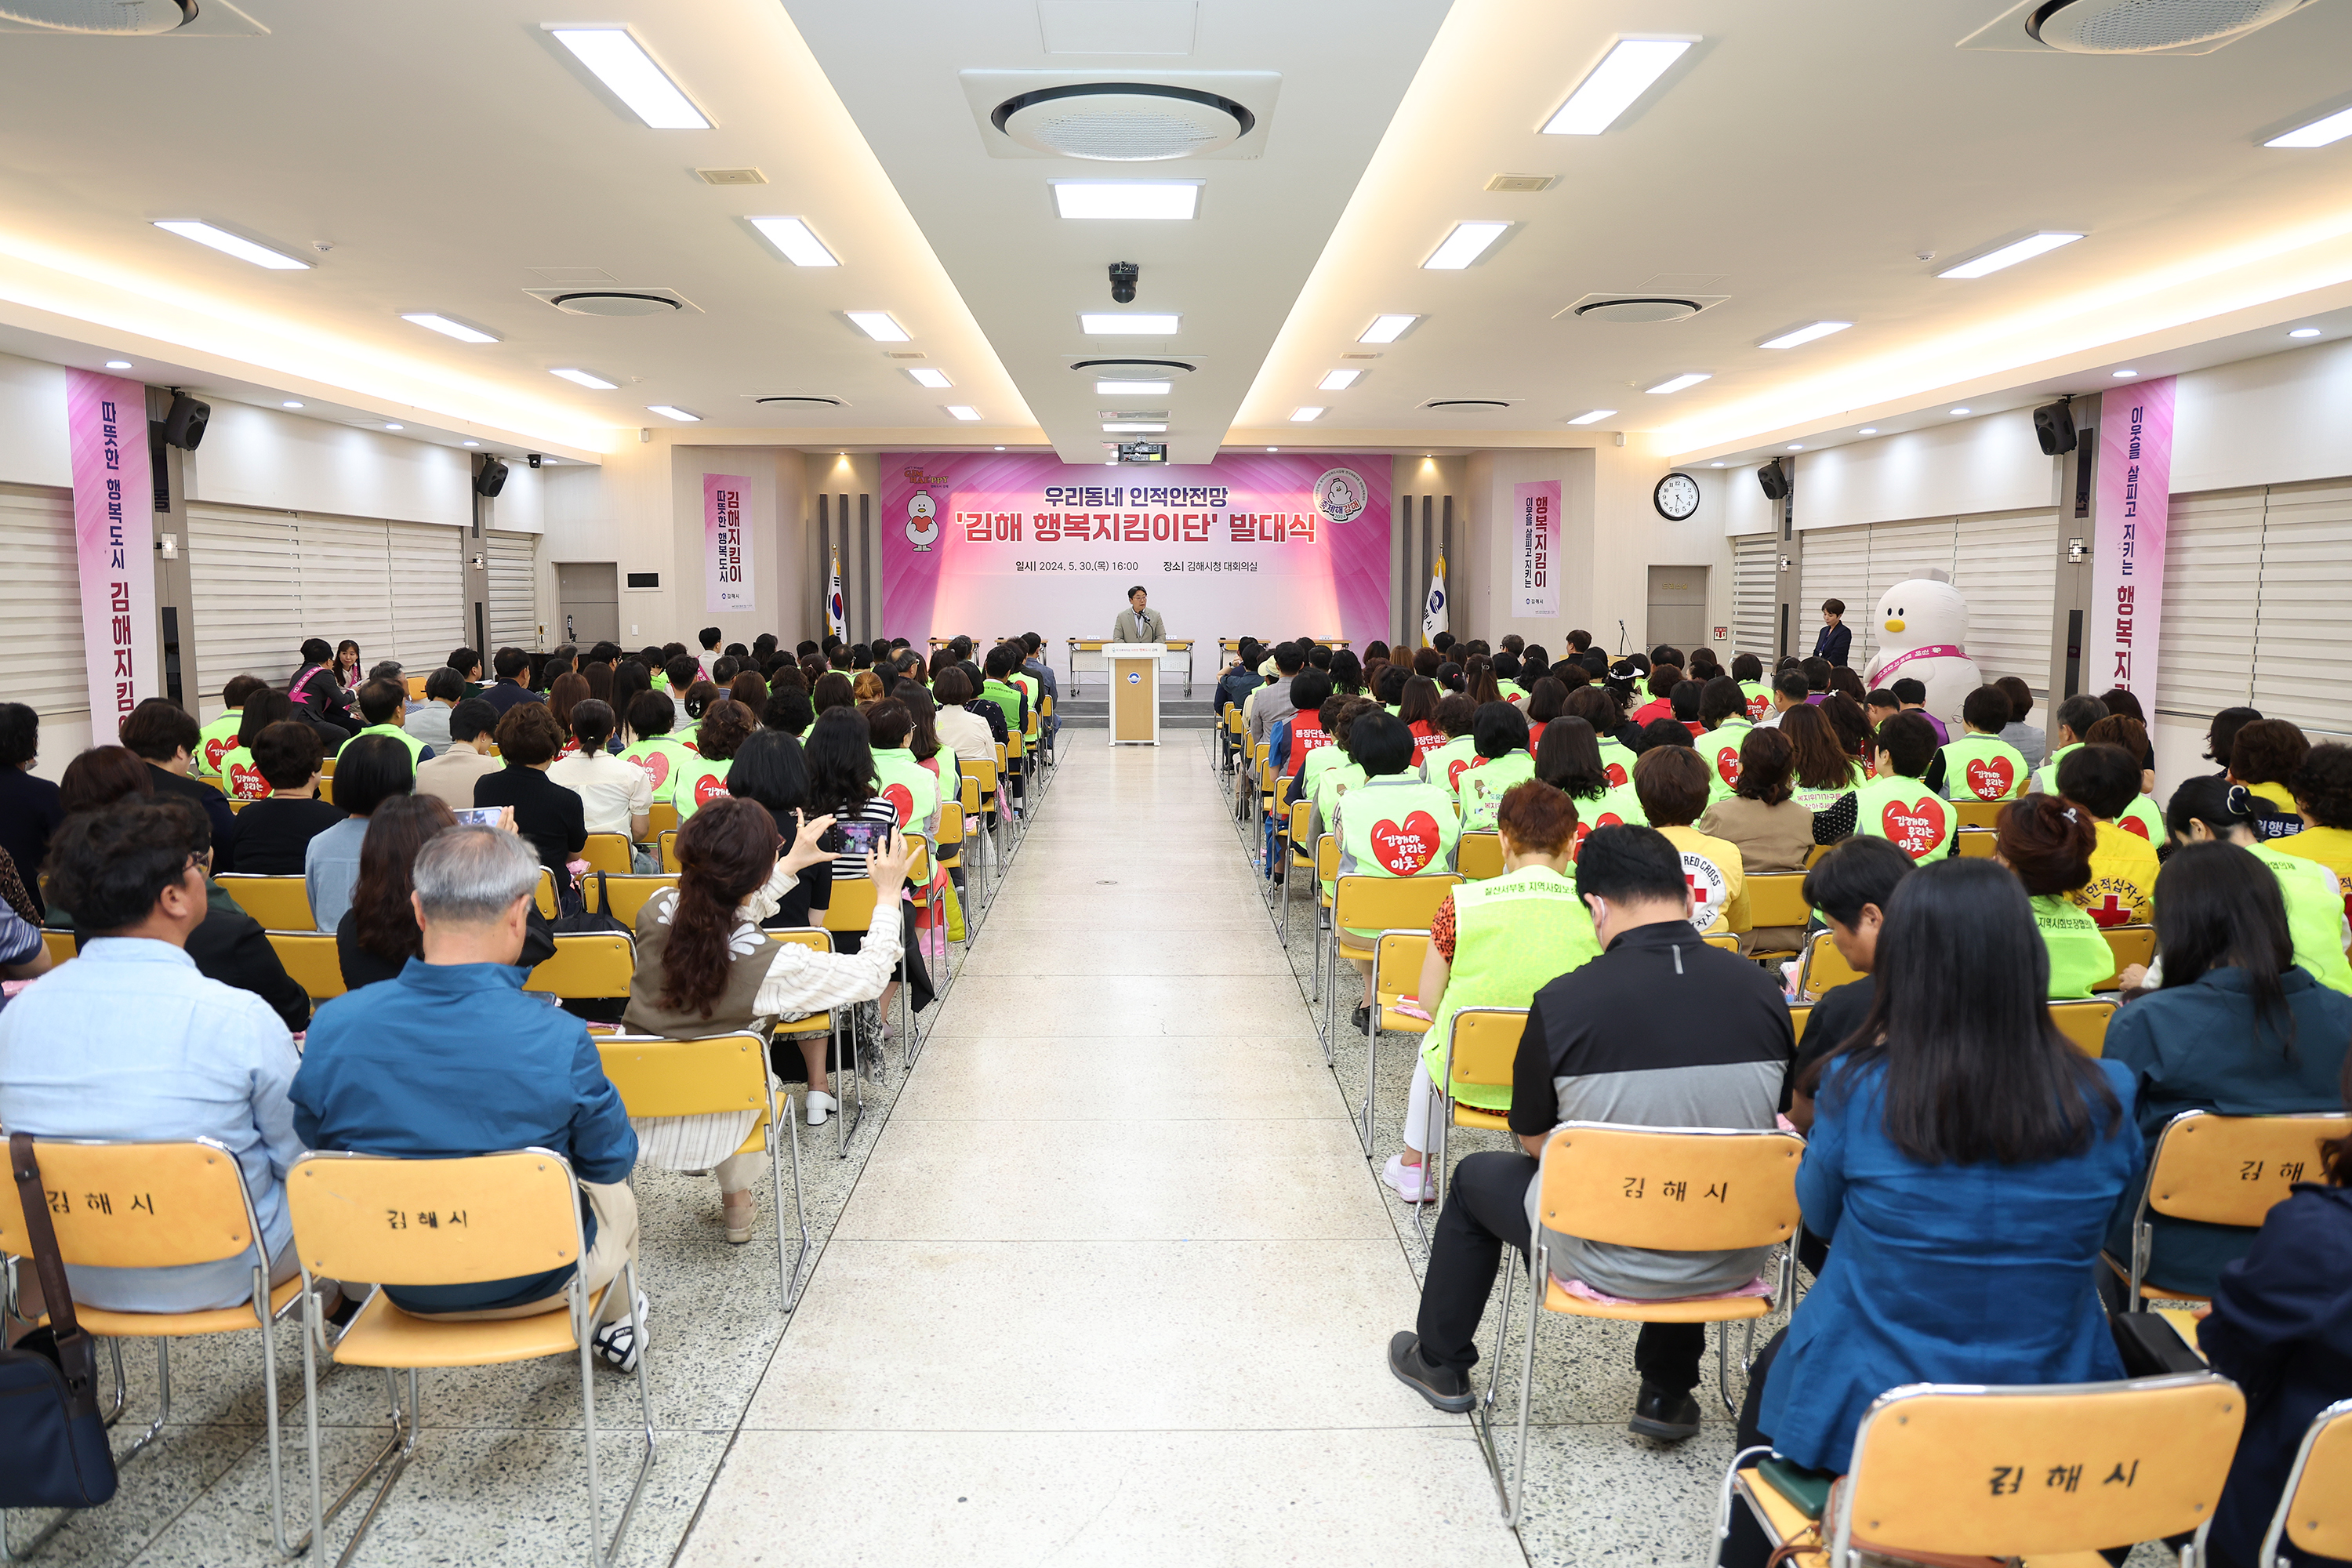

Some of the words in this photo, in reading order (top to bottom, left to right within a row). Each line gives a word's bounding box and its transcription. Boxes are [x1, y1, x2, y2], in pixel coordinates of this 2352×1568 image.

[102, 401, 119, 470] 따뜻한
[2129, 406, 2143, 460] 이웃을
[1045, 487, 1123, 507] 우리동네
[1130, 487, 1229, 507] 인적안전망
[2125, 466, 2140, 517] 살피고
[717, 490, 727, 528] 따뜻한
[107, 479, 125, 570] 행복도시
[1229, 513, 1316, 543] 발대식
[727, 491, 742, 583] 김해지킴이
[1534, 496, 1548, 588] 행복지킴이
[718, 532, 728, 583] 행복도시
[2122, 524, 2136, 575] 지키는
[1039, 561, 1066, 572] 2024.
[1068, 561, 1077, 572] 5.
[1112, 561, 1139, 571] 16:00
[1187, 561, 1222, 572] 김해시청
[1223, 561, 1258, 572] 대회의실
[234, 775, 260, 783] 김해야
[1973, 770, 2001, 779] 김해야
[1984, 779, 2005, 787] 우리는
[243, 782, 263, 792] 우리는
[1892, 815, 1929, 826] 김해야
[1381, 834, 1421, 848] 김해야
[1907, 826, 1935, 838] 우리는
[1398, 842, 1427, 857] 우리는
[1683, 855, 1700, 867] RED
[1700, 860, 1721, 887] CROSS
[1485, 882, 1526, 896] 칠산서부동
